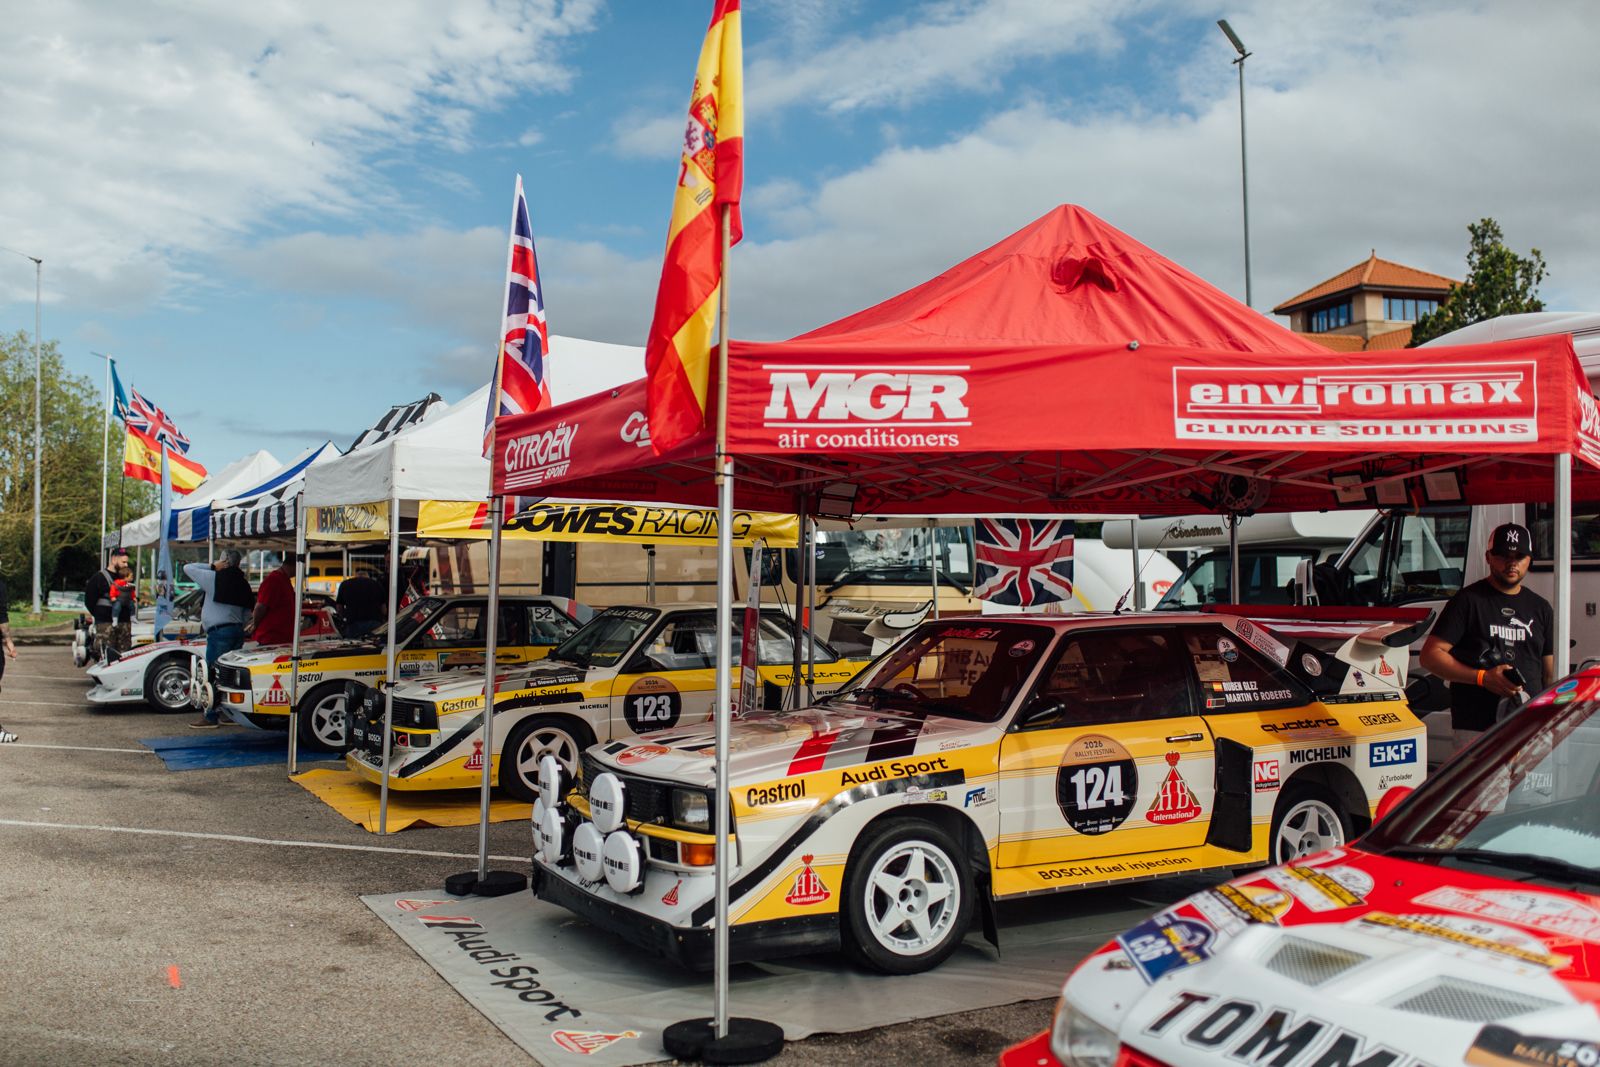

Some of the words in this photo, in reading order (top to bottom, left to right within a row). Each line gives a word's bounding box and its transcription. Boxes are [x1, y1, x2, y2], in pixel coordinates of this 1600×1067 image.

[764, 372, 969, 420] MGR
[1190, 378, 1522, 405] enviromax
[778, 429, 809, 448] air
[816, 428, 959, 447] conditioners
[1186, 423, 1325, 436] CLIMATE
[1341, 422, 1529, 436] SOLUTIONS
[504, 422, 578, 472] CITROËN
[544, 463, 569, 480] SPORT
[1506, 530, 1519, 543] NY
[535, 607, 553, 620] 52
[1490, 624, 1526, 641] PUMA
[298, 672, 323, 683] astrol
[441, 698, 479, 713] Castrol
[1225, 693, 1252, 703] MARTIN
[1253, 692, 1259, 701] G
[1260, 690, 1292, 701] ROBERTS
[633, 695, 671, 722] 123
[1261, 718, 1339, 732] quattro
[1359, 713, 1401, 727] BOGE
[1084, 741, 1104, 750] 2026
[1290, 746, 1351, 763] MICHELIN
[1372, 743, 1413, 764] SKF
[840, 766, 887, 786] Audi
[890, 757, 949, 777] Sport
[1255, 761, 1279, 781] NG
[1385, 773, 1413, 783] Turbolader
[746, 779, 806, 808] Castrol
[1070, 765, 1125, 811] 124
[1157, 779, 1189, 811] HB
[1153, 810, 1195, 821] international
[1038, 866, 1094, 881] BOSCH
[1095, 863, 1126, 874] fuel
[1128, 856, 1193, 871] injection
[795, 873, 821, 896] HB
[444, 930, 520, 965] Audi
[490, 965, 582, 1022] Sport
[1149, 991, 1402, 1067] TOMM
